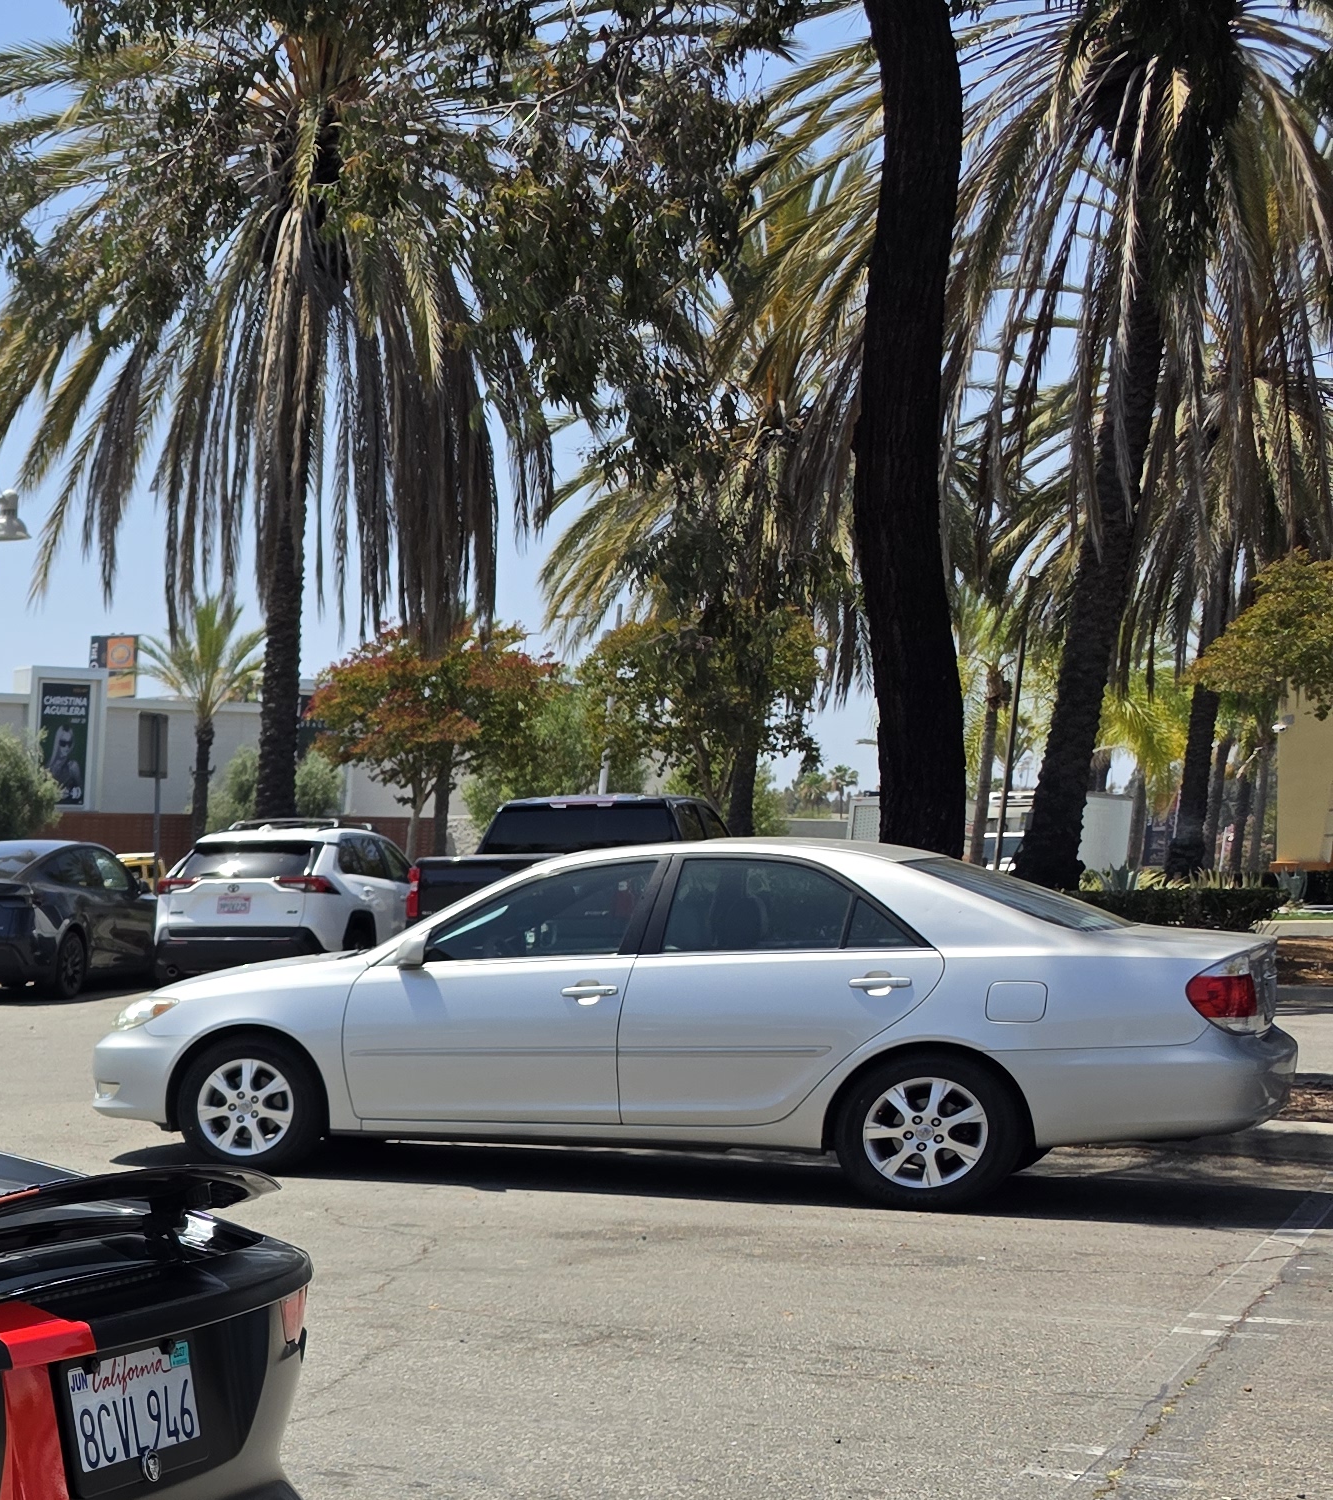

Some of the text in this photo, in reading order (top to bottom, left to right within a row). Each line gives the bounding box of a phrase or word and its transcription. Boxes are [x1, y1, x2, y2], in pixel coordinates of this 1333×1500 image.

[44, 695, 87, 706] CHRISTINA
[44, 705, 86, 716] AGUILERA
[70, 1372, 89, 1393] JUN
[92, 1351, 171, 1395] California
[79, 1378, 195, 1470] 8CVL946
